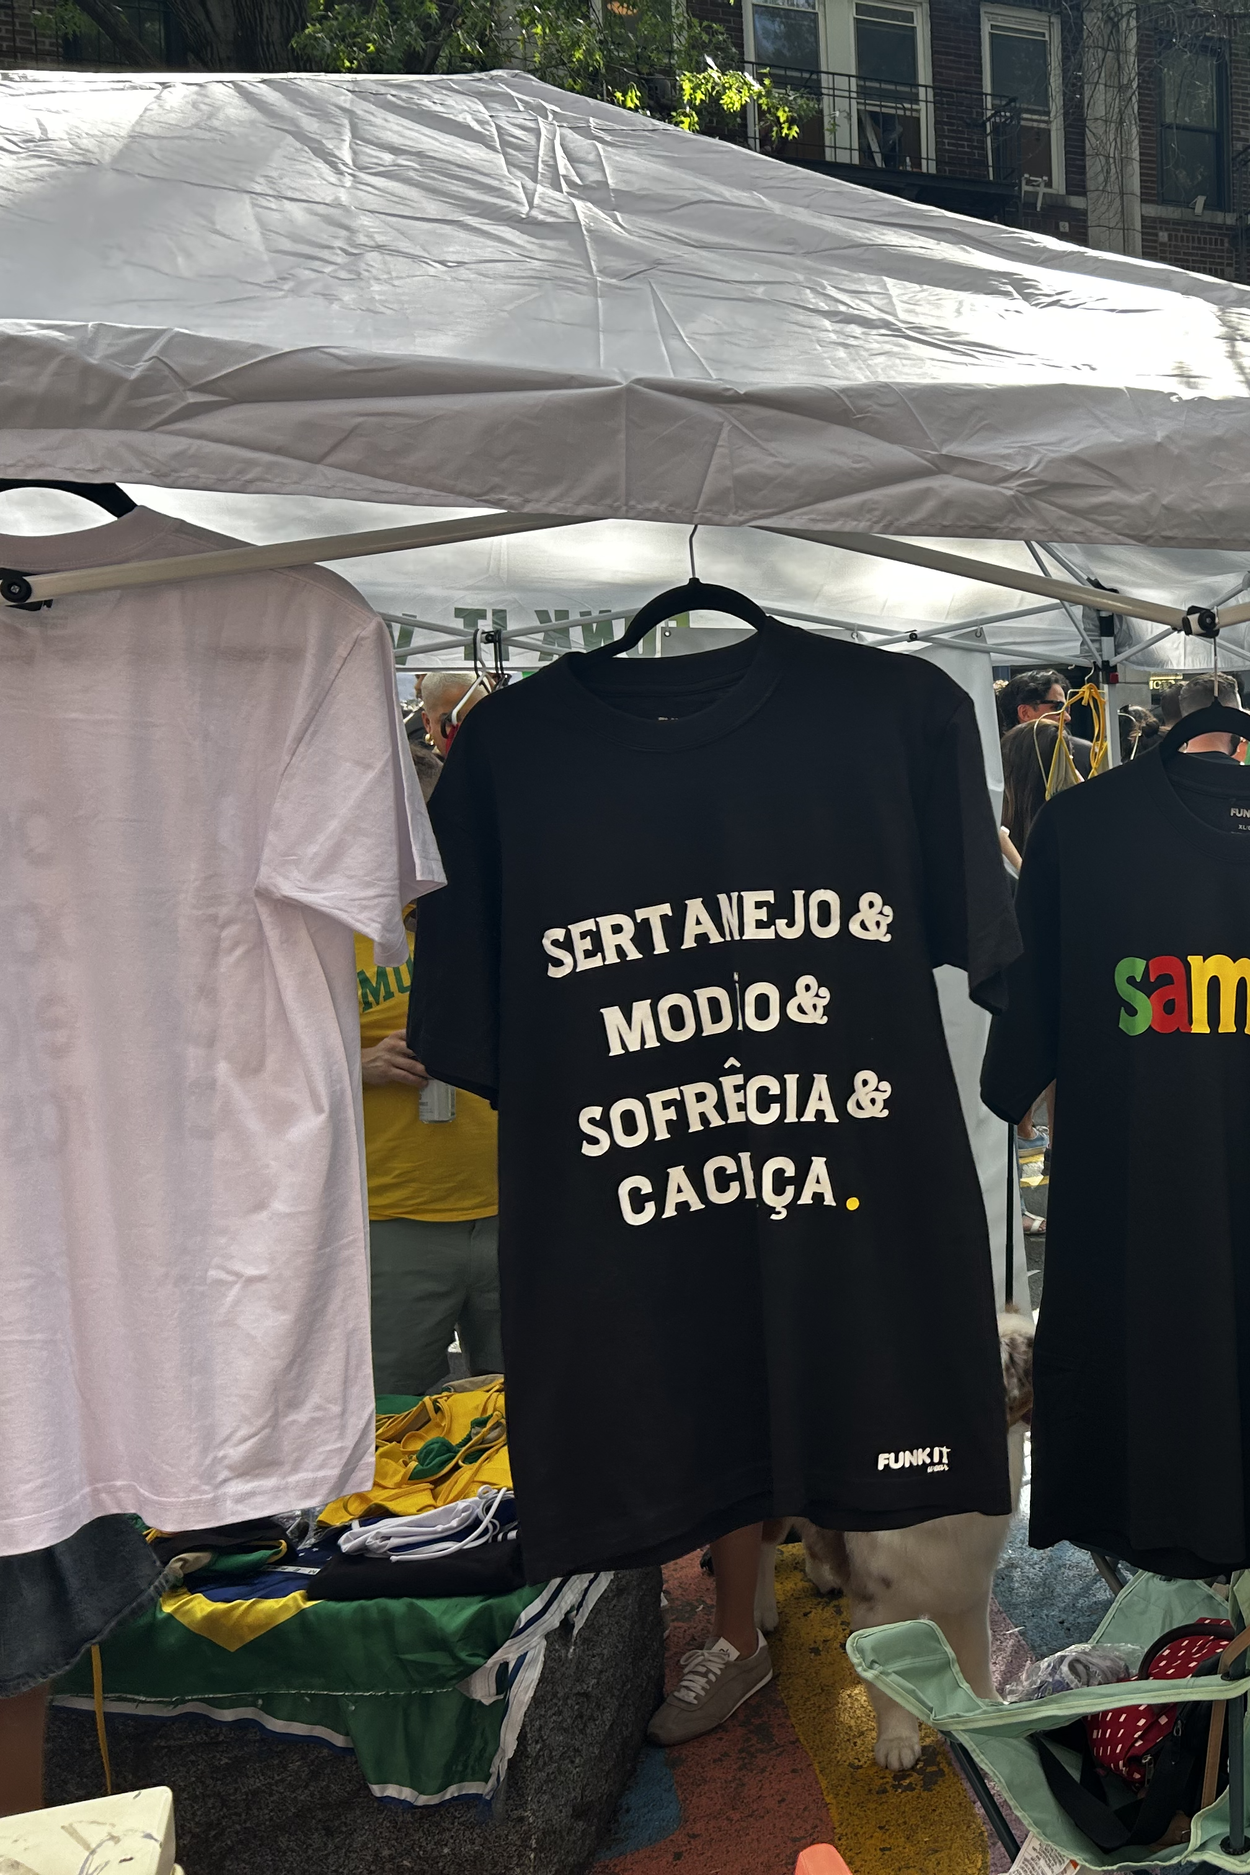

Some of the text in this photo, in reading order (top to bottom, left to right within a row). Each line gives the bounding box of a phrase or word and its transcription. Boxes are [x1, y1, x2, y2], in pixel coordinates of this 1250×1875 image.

[542, 889, 894, 979] SERTANEJO &
[786, 974, 831, 1025] &
[847, 1069, 893, 1119] &
